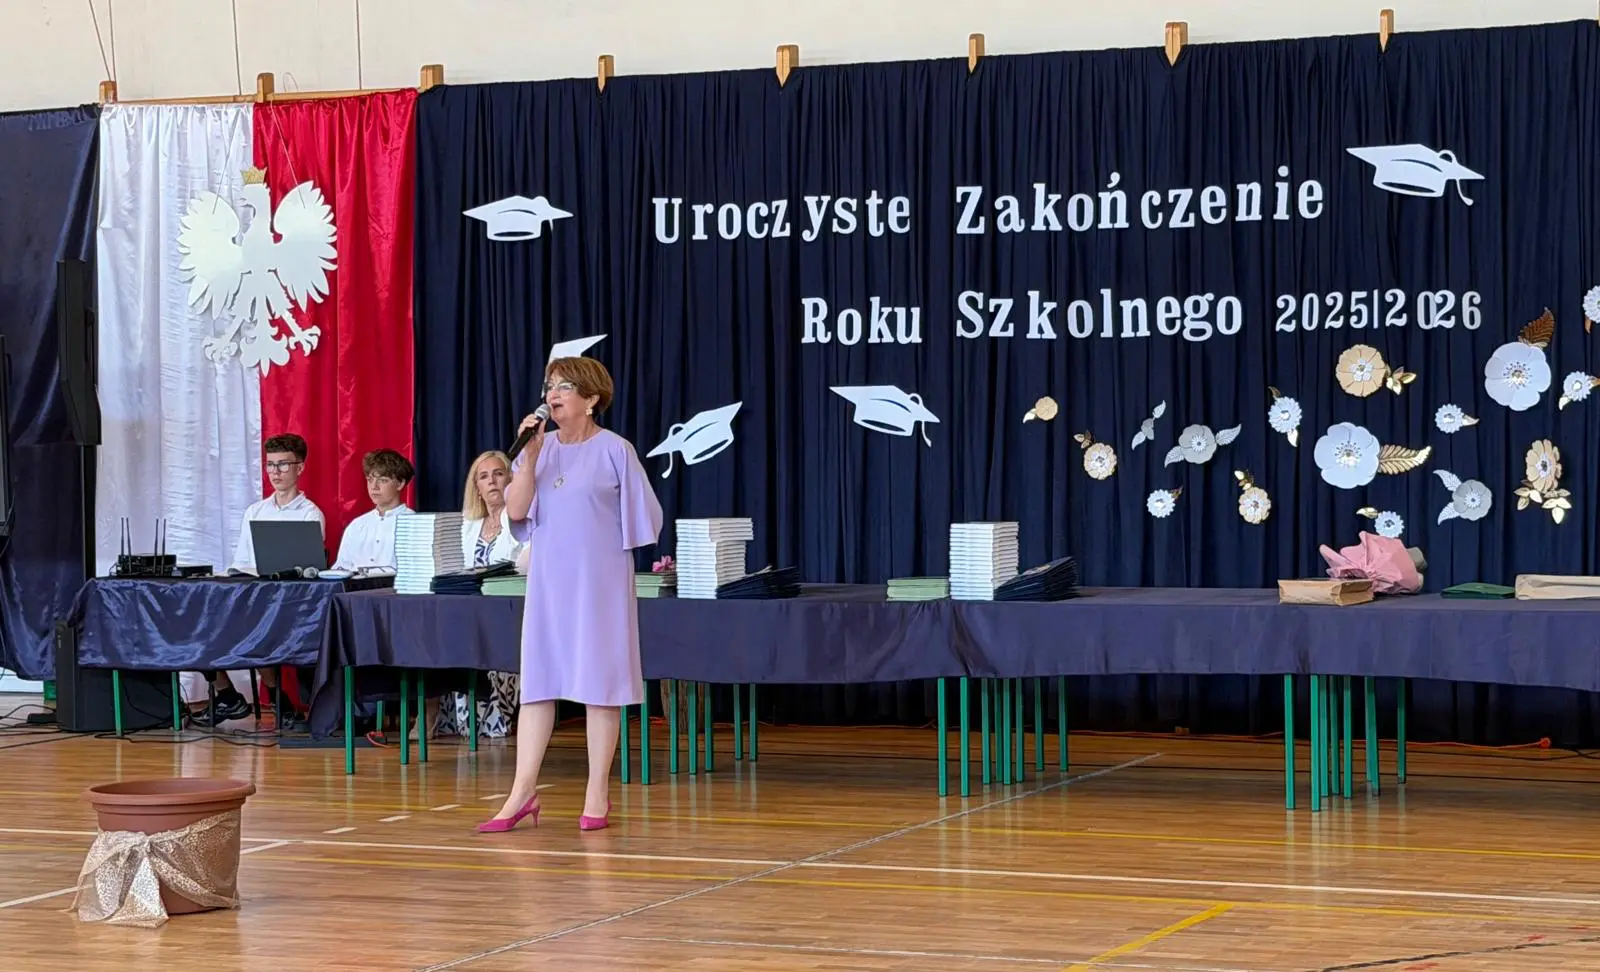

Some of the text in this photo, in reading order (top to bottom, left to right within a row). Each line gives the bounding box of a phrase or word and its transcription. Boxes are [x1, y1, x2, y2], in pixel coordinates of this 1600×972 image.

[652, 165, 1324, 244] Uroczyste Zakończenie
[801, 296, 923, 346] Roku
[955, 288, 1243, 342] Szkolnego
